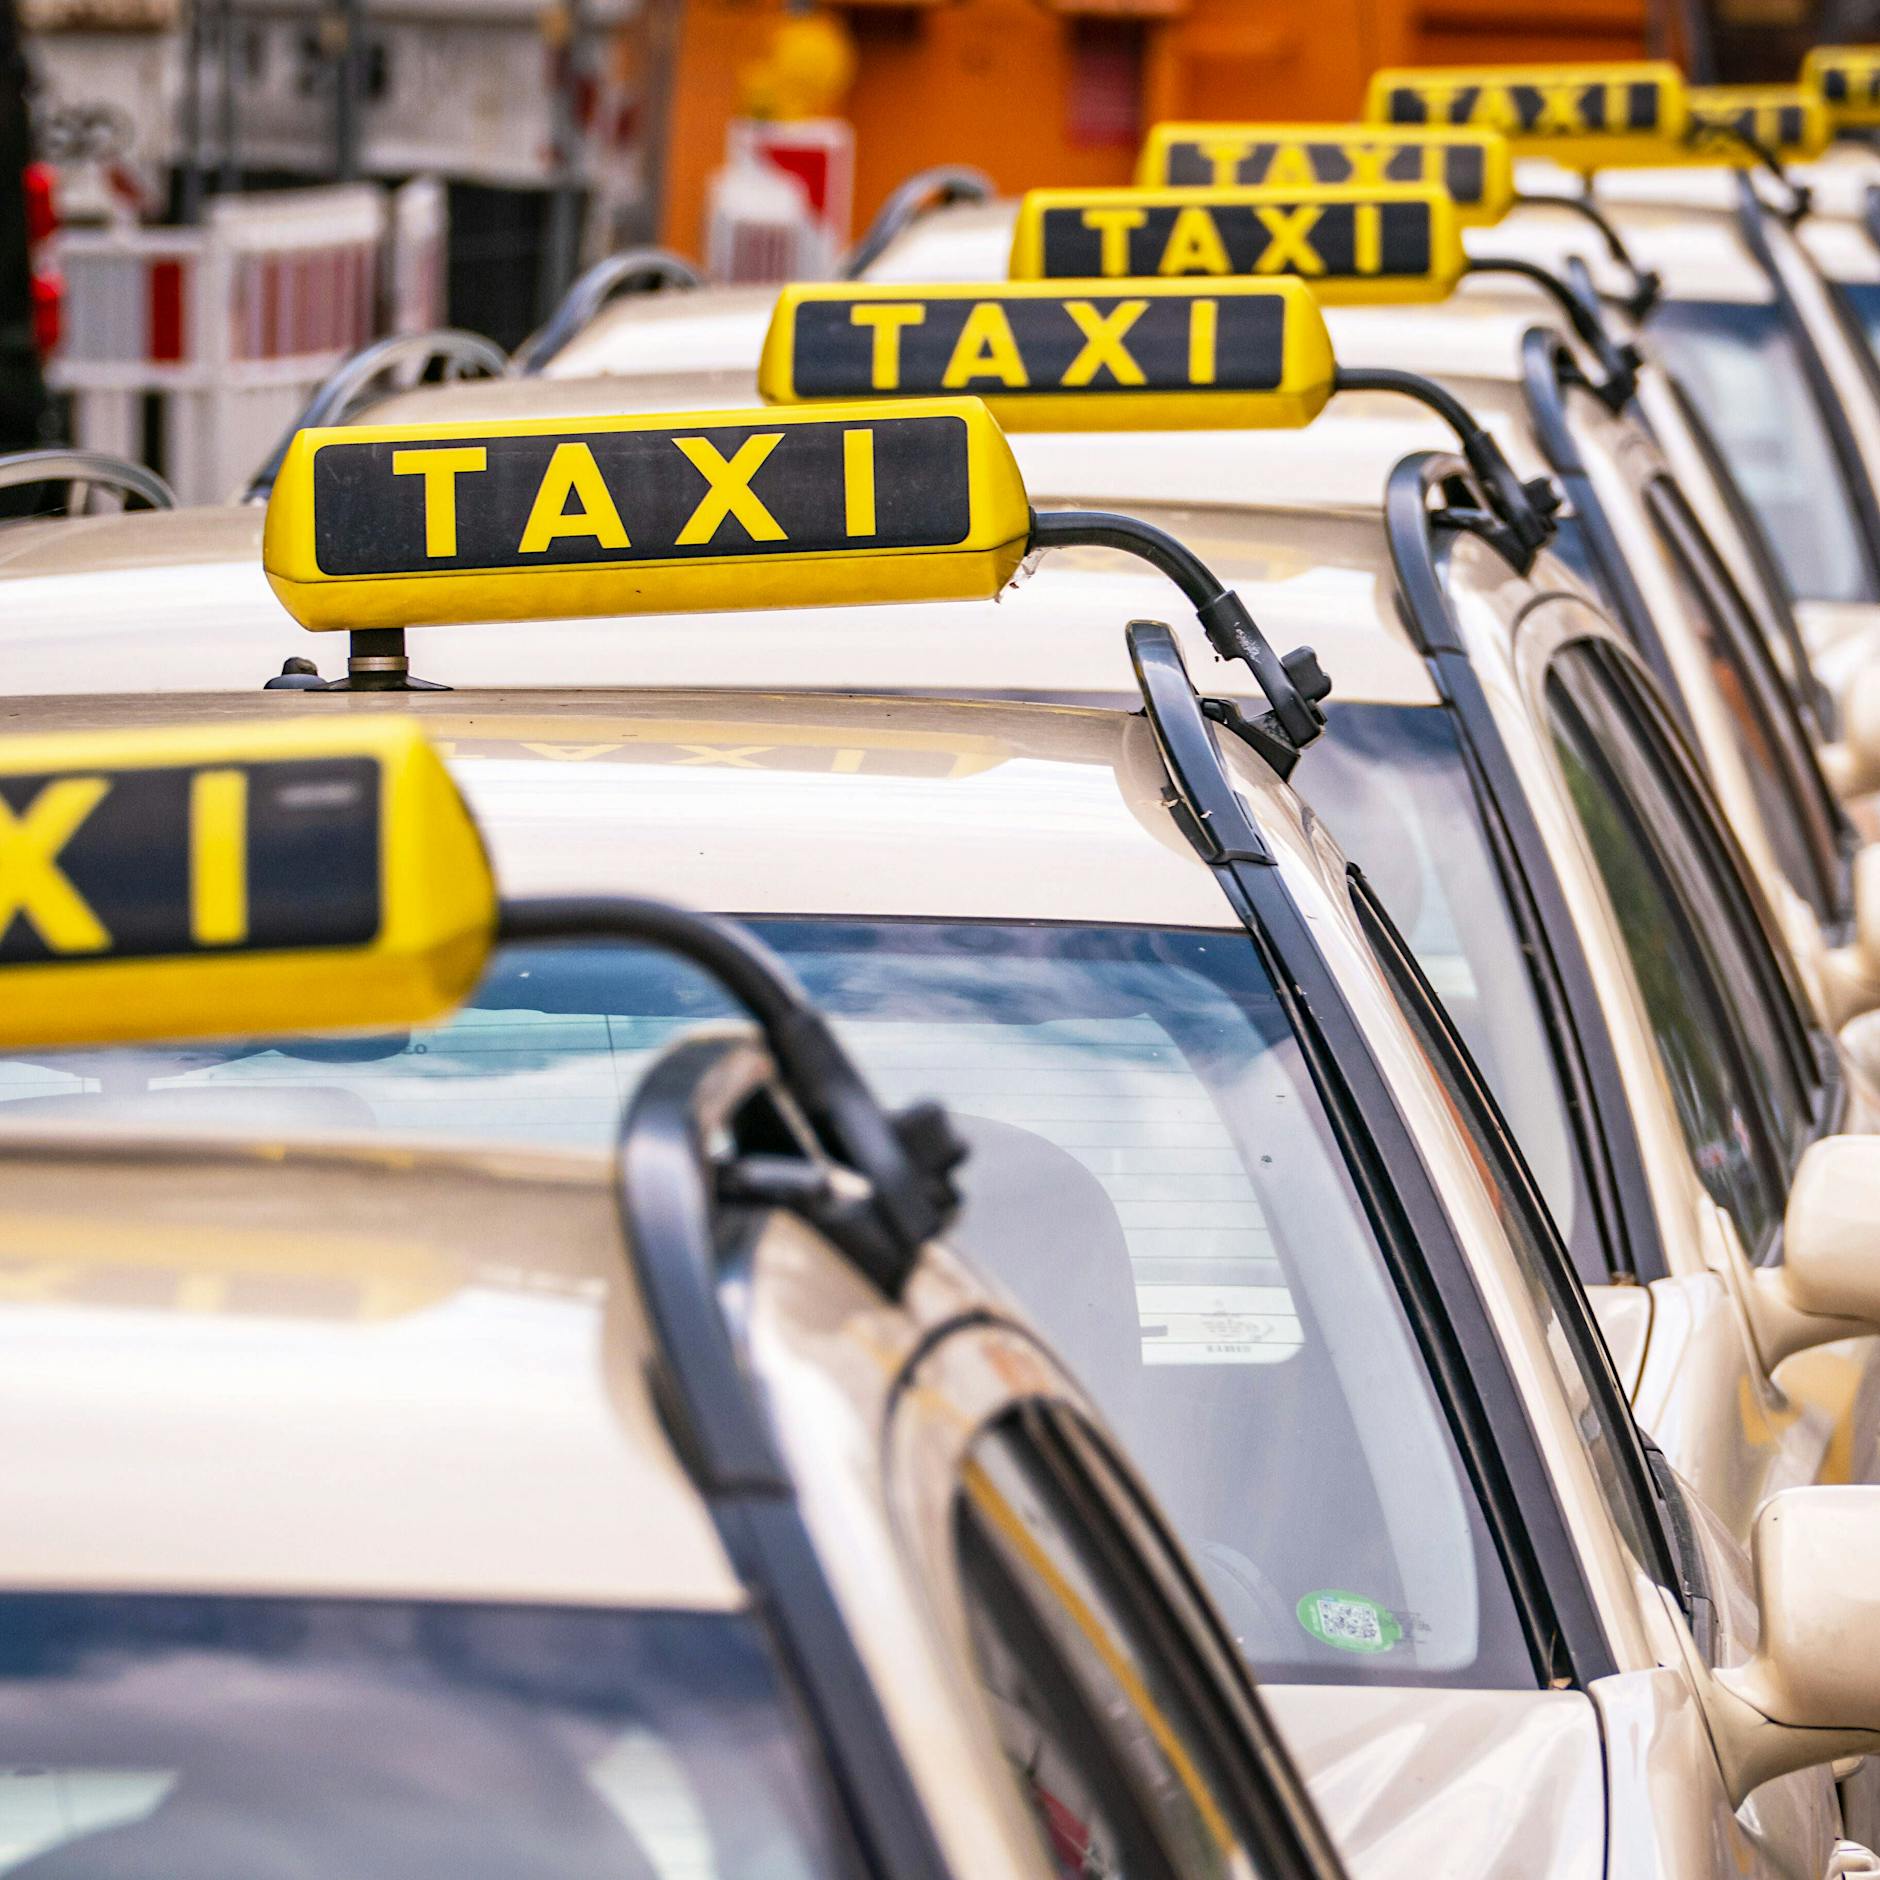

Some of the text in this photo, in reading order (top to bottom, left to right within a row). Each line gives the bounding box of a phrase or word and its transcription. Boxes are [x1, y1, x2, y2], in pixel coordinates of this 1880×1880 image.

[1410, 86, 1629, 130] TAXI
[1198, 143, 1446, 186] TAXI
[1082, 204, 1383, 276] TAXI
[850, 299, 1218, 389] TAXI
[391, 428, 877, 558] TAXI
